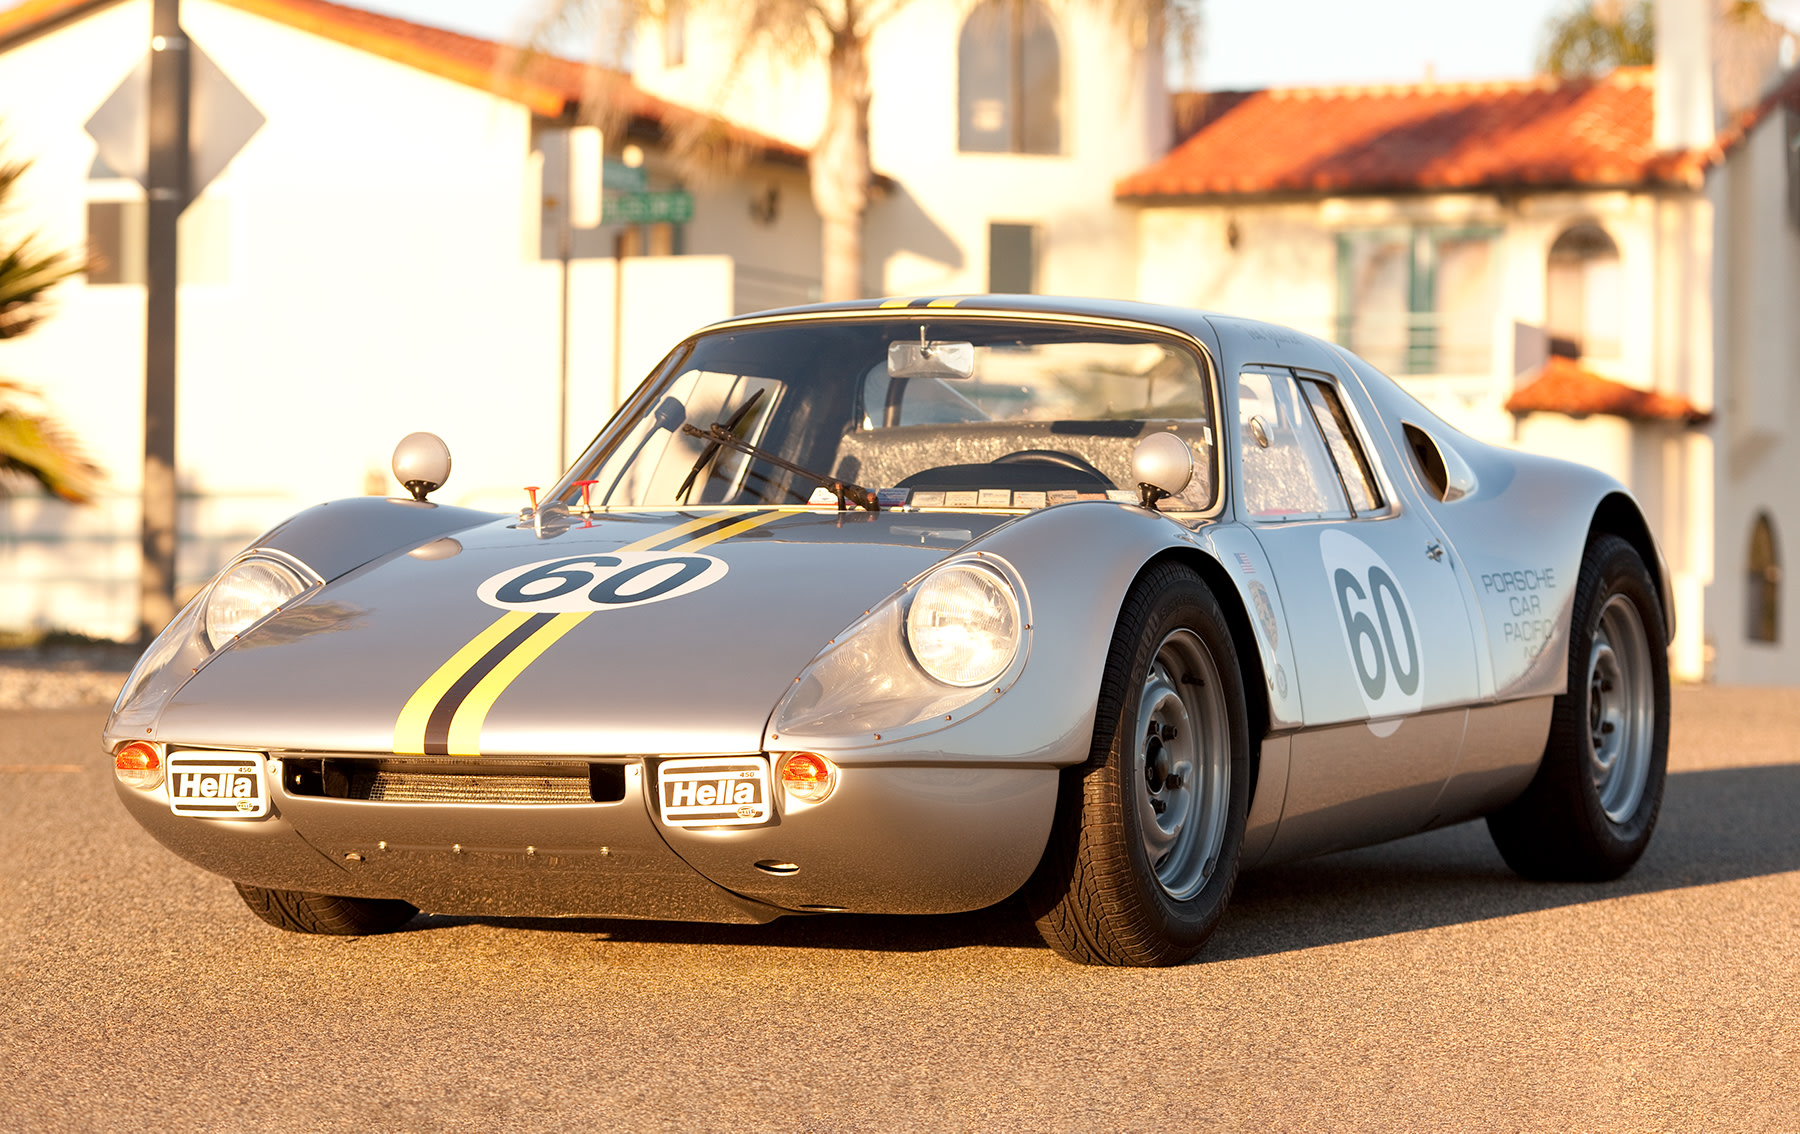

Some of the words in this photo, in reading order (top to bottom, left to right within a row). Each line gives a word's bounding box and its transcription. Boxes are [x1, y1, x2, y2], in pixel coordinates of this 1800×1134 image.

[495, 555, 714, 605] 60
[1481, 568, 1556, 594] PORSCHE
[1509, 595, 1541, 617] CAR
[1334, 565, 1420, 701] 60
[178, 773, 252, 798] Hella
[671, 779, 755, 806] Hella
